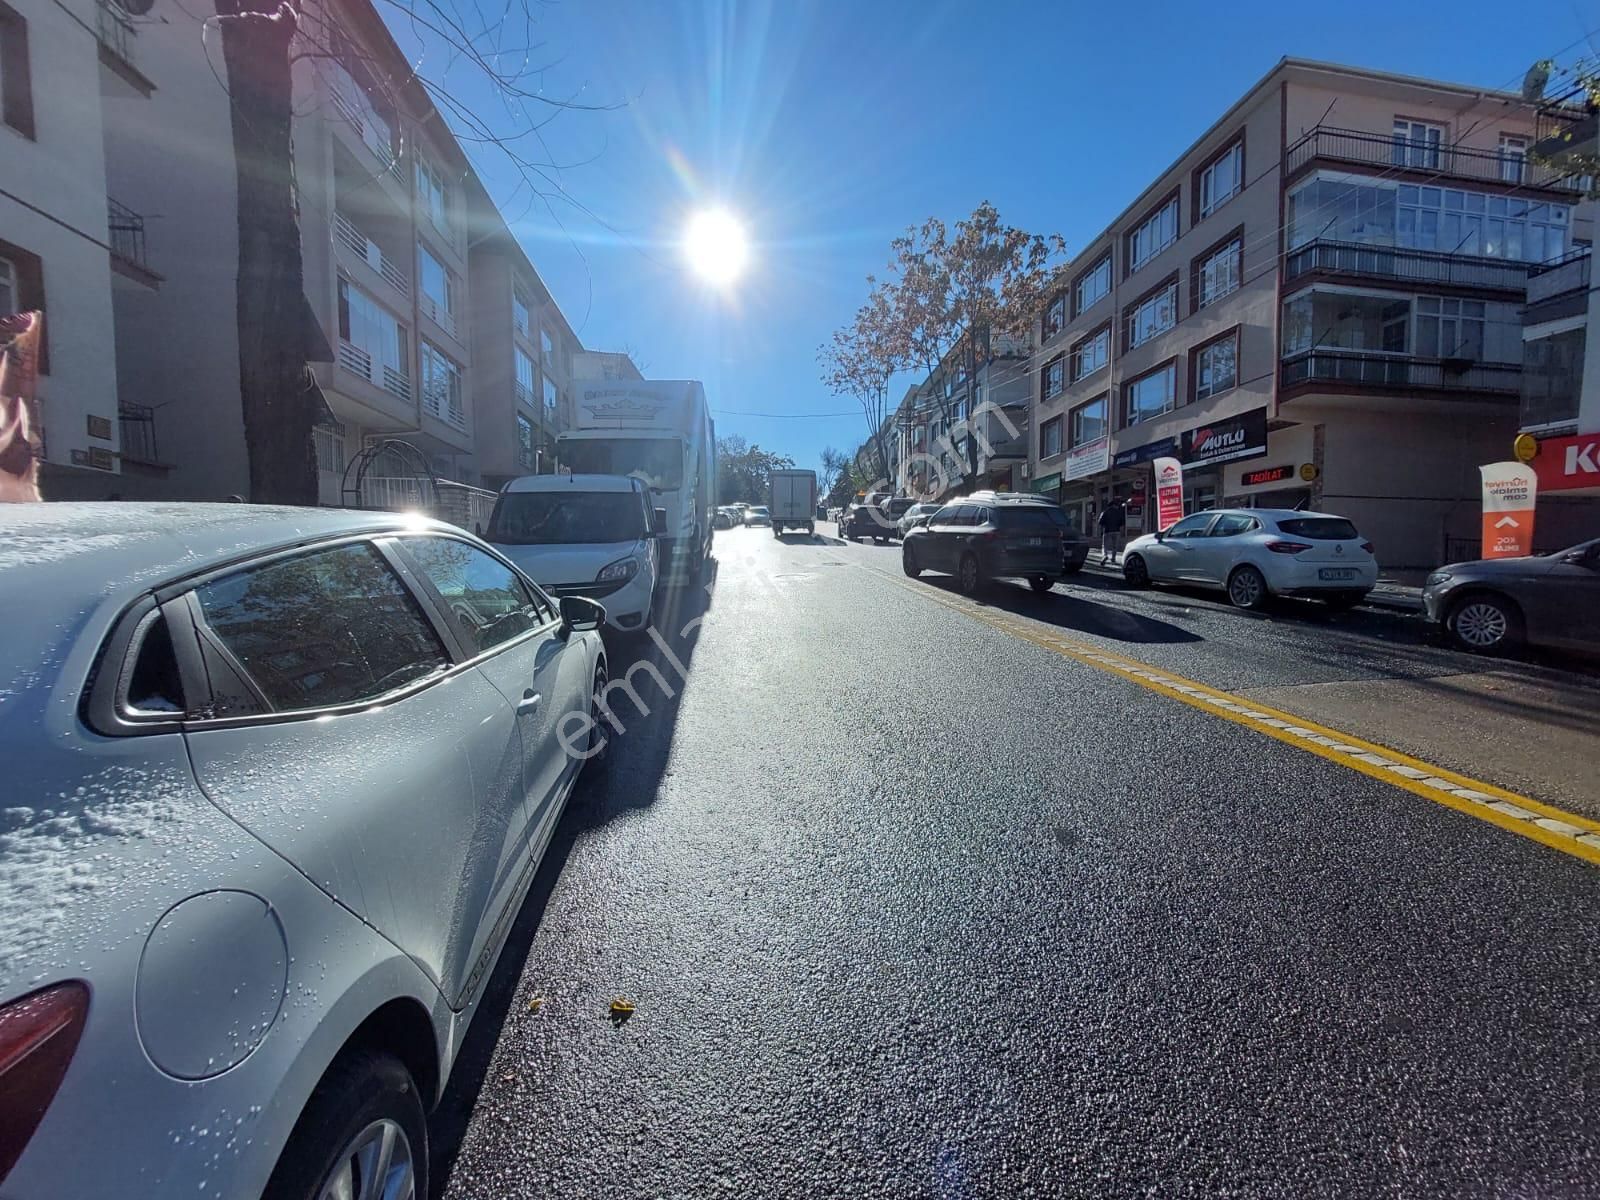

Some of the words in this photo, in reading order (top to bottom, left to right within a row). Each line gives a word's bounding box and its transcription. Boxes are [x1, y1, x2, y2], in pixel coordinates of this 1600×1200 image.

[1201, 429, 1245, 451] MUTLU
[1564, 443, 1600, 475] K
[466, 948, 490, 994] CLIO
